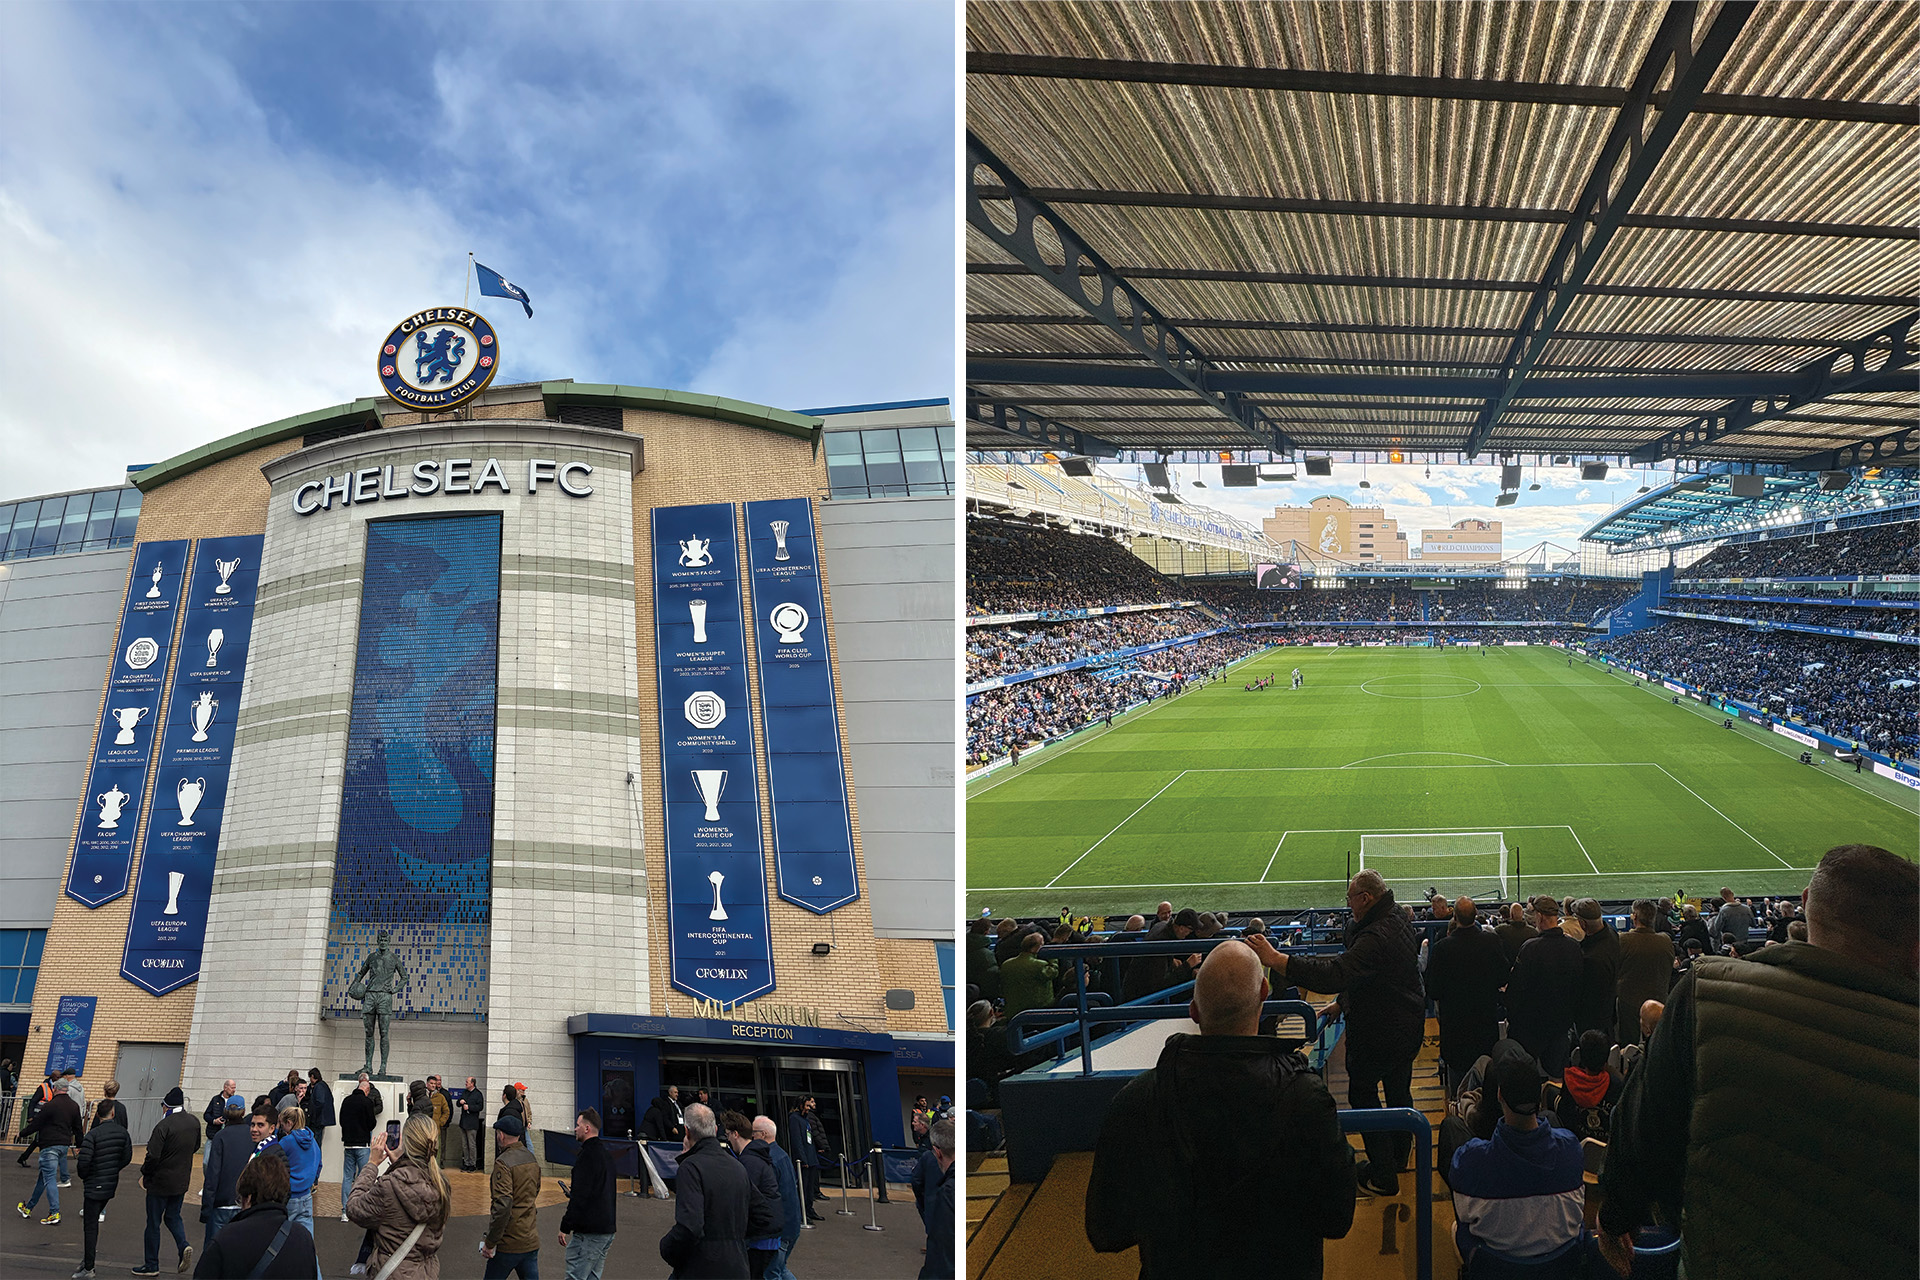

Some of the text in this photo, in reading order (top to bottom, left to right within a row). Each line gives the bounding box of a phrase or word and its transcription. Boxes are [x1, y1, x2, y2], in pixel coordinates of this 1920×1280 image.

[401, 309, 477, 333] CHELSEA
[395, 379, 476, 403] FOOTBALL CLUB
[292, 458, 594, 516] CHELSEA FC
[1163, 509, 1243, 540] CHELSEA FOOTBALL CLUB
[687, 932, 754, 940] INTERCONTINENTAL
[692, 997, 820, 1028] MILLENNIUM
[631, 1022, 666, 1032] CHELSEA
[731, 1024, 794, 1040] RECEPTION
[844, 1037, 867, 1046] CHELSEA
[894, 1050, 924, 1059] ELSEA
[602, 1059, 633, 1068] CHELSEA
